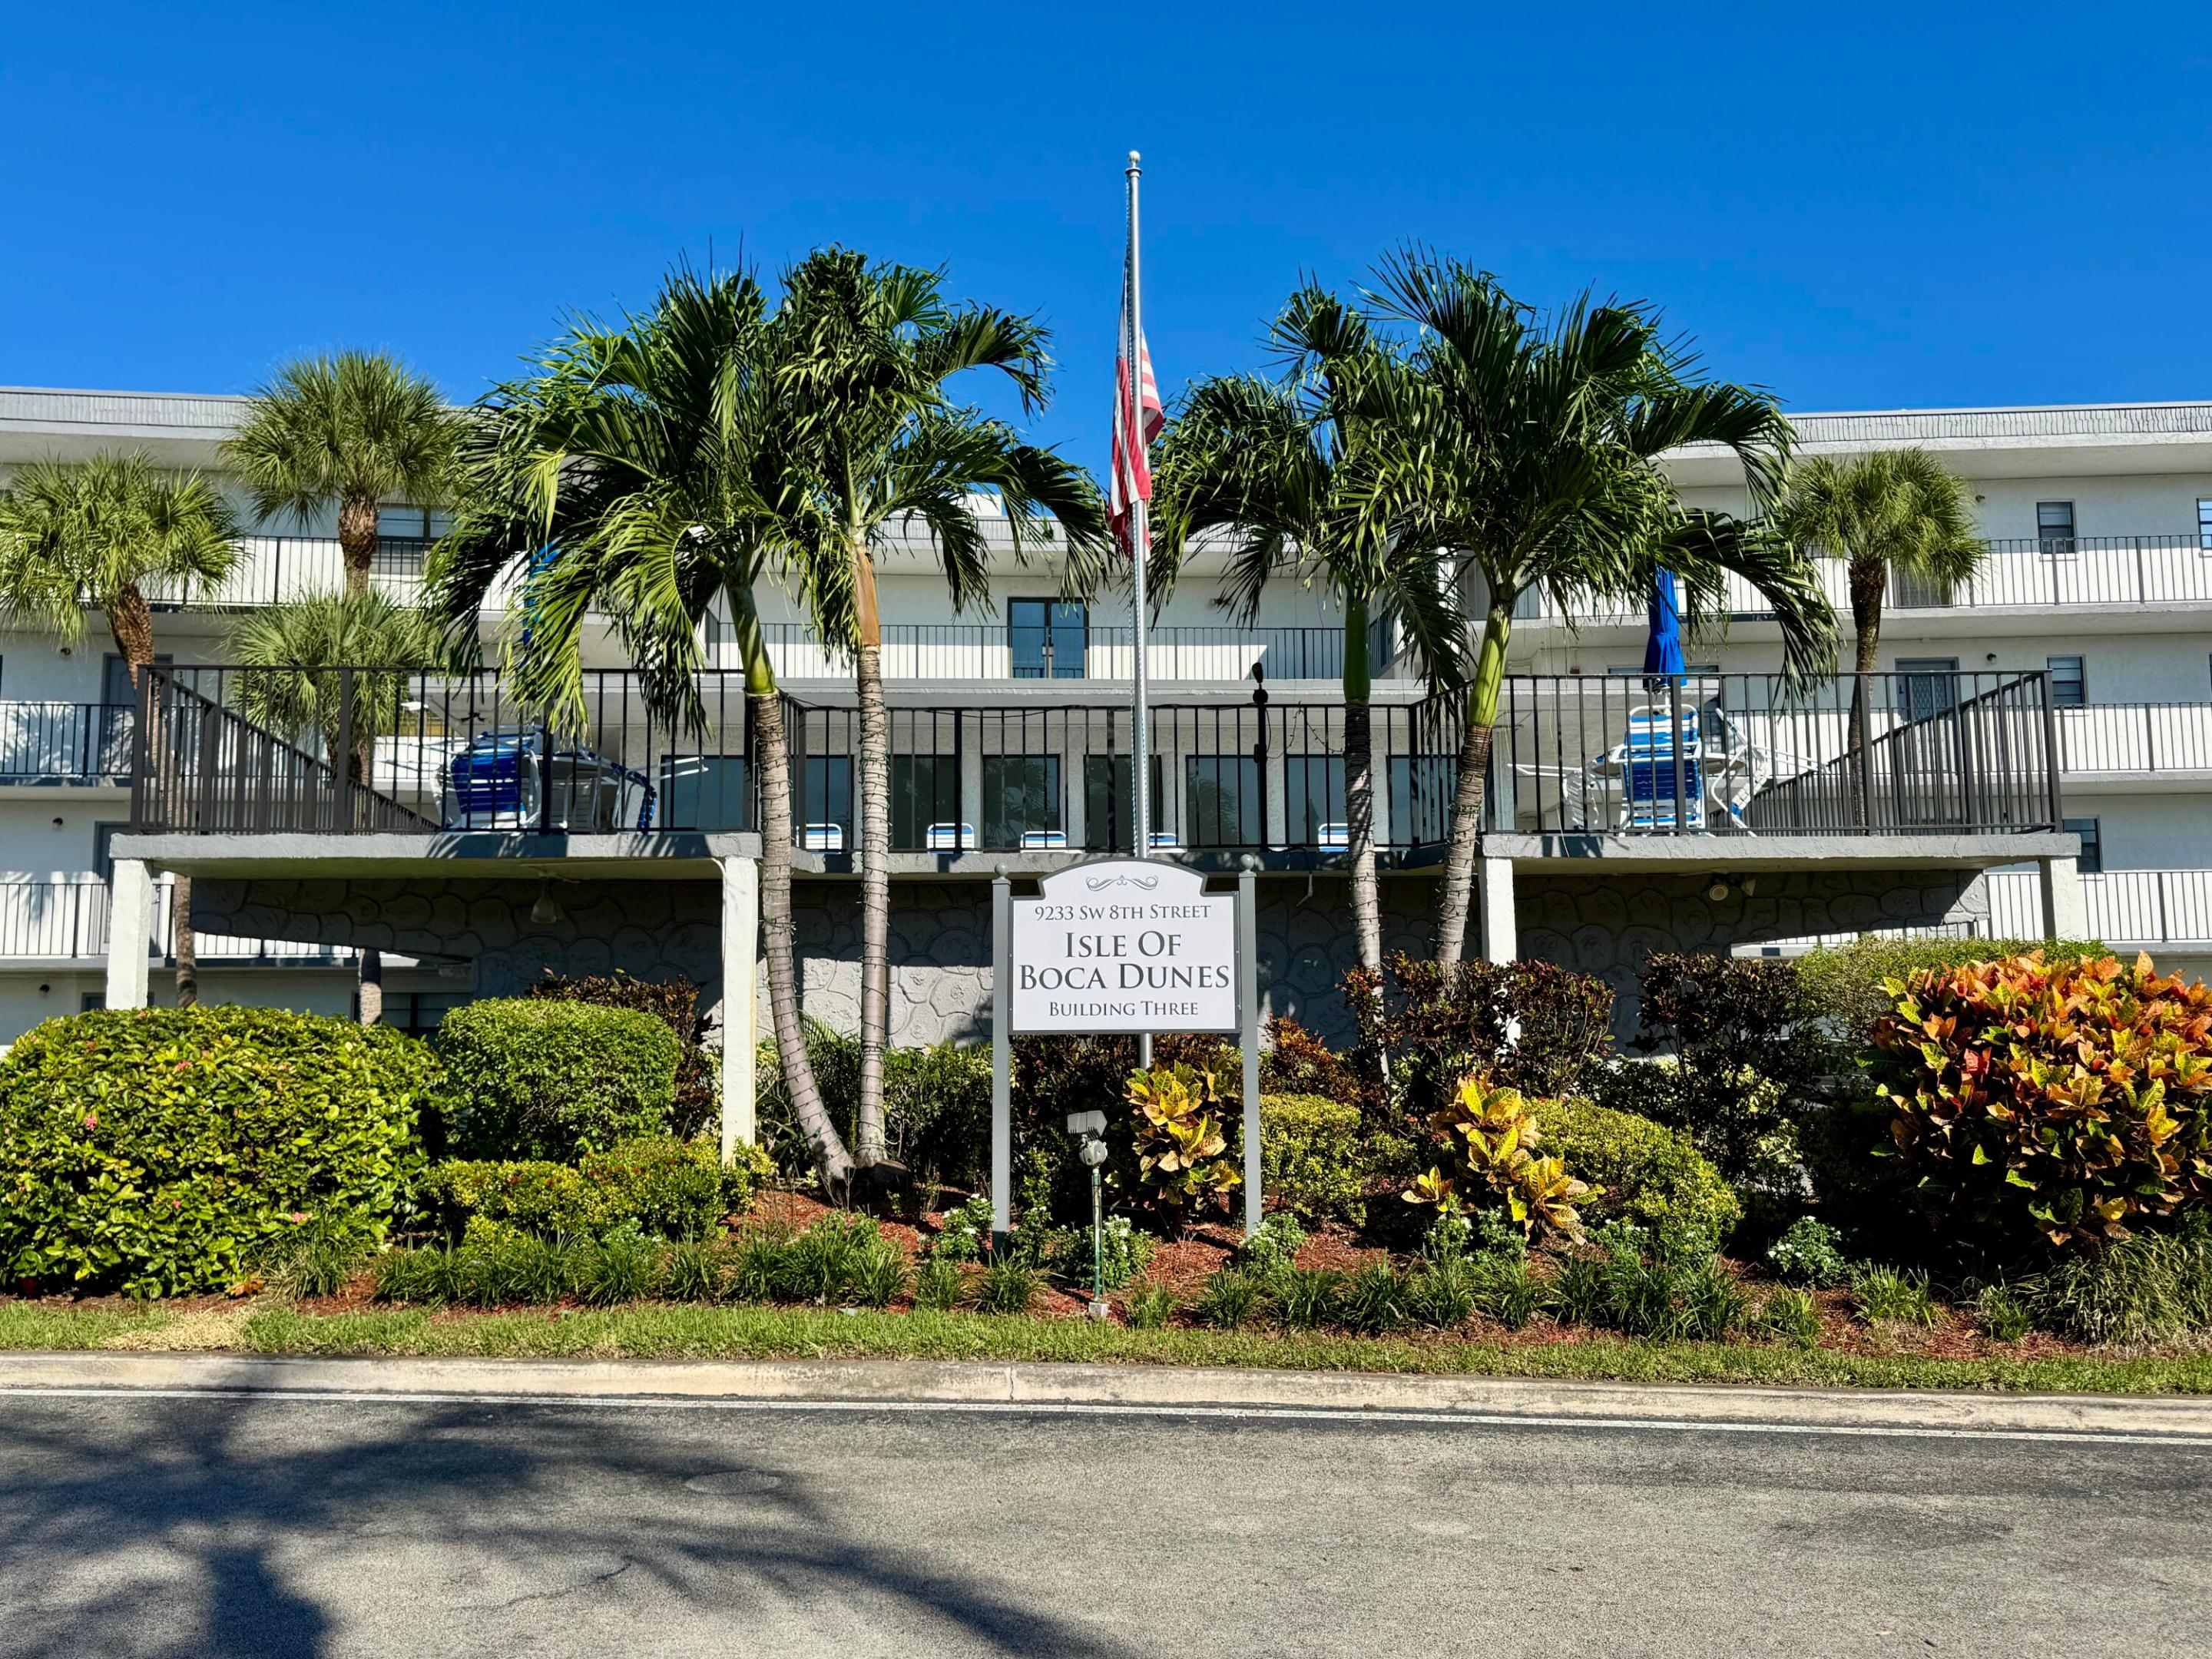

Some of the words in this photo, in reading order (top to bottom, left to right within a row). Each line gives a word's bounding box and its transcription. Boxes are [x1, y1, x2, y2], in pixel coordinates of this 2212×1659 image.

[1035, 906, 1074, 921] 9233
[1079, 906, 1104, 920] SW
[1109, 905, 1143, 920] 8TH
[1150, 904, 1211, 919] STREET
[1065, 932, 1127, 958] ISLE
[1137, 930, 1181, 957] OF
[1019, 965, 1107, 990] BOCA
[1118, 963, 1230, 989] DUNES
[1049, 1002, 1135, 1016] BUILDING
[1140, 1001, 1198, 1015] THREE
